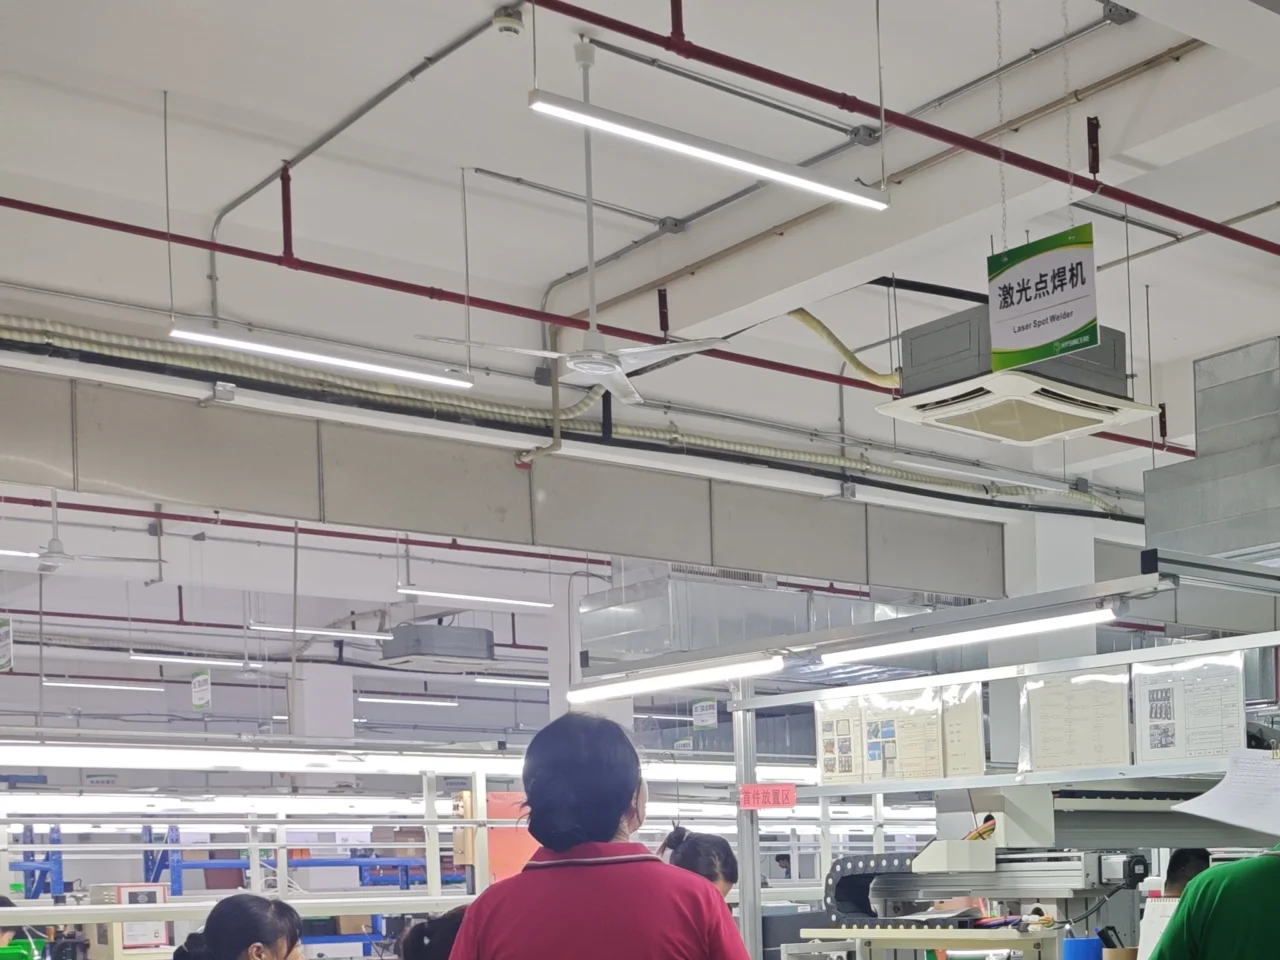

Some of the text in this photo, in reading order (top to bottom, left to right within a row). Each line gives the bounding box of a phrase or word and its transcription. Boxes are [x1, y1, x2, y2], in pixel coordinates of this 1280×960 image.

[998, 261, 1086, 309] 激光点焊机
[1013, 310, 1075, 334] Laser Spot Welder
[742, 788, 791, 805] 首件放置区
